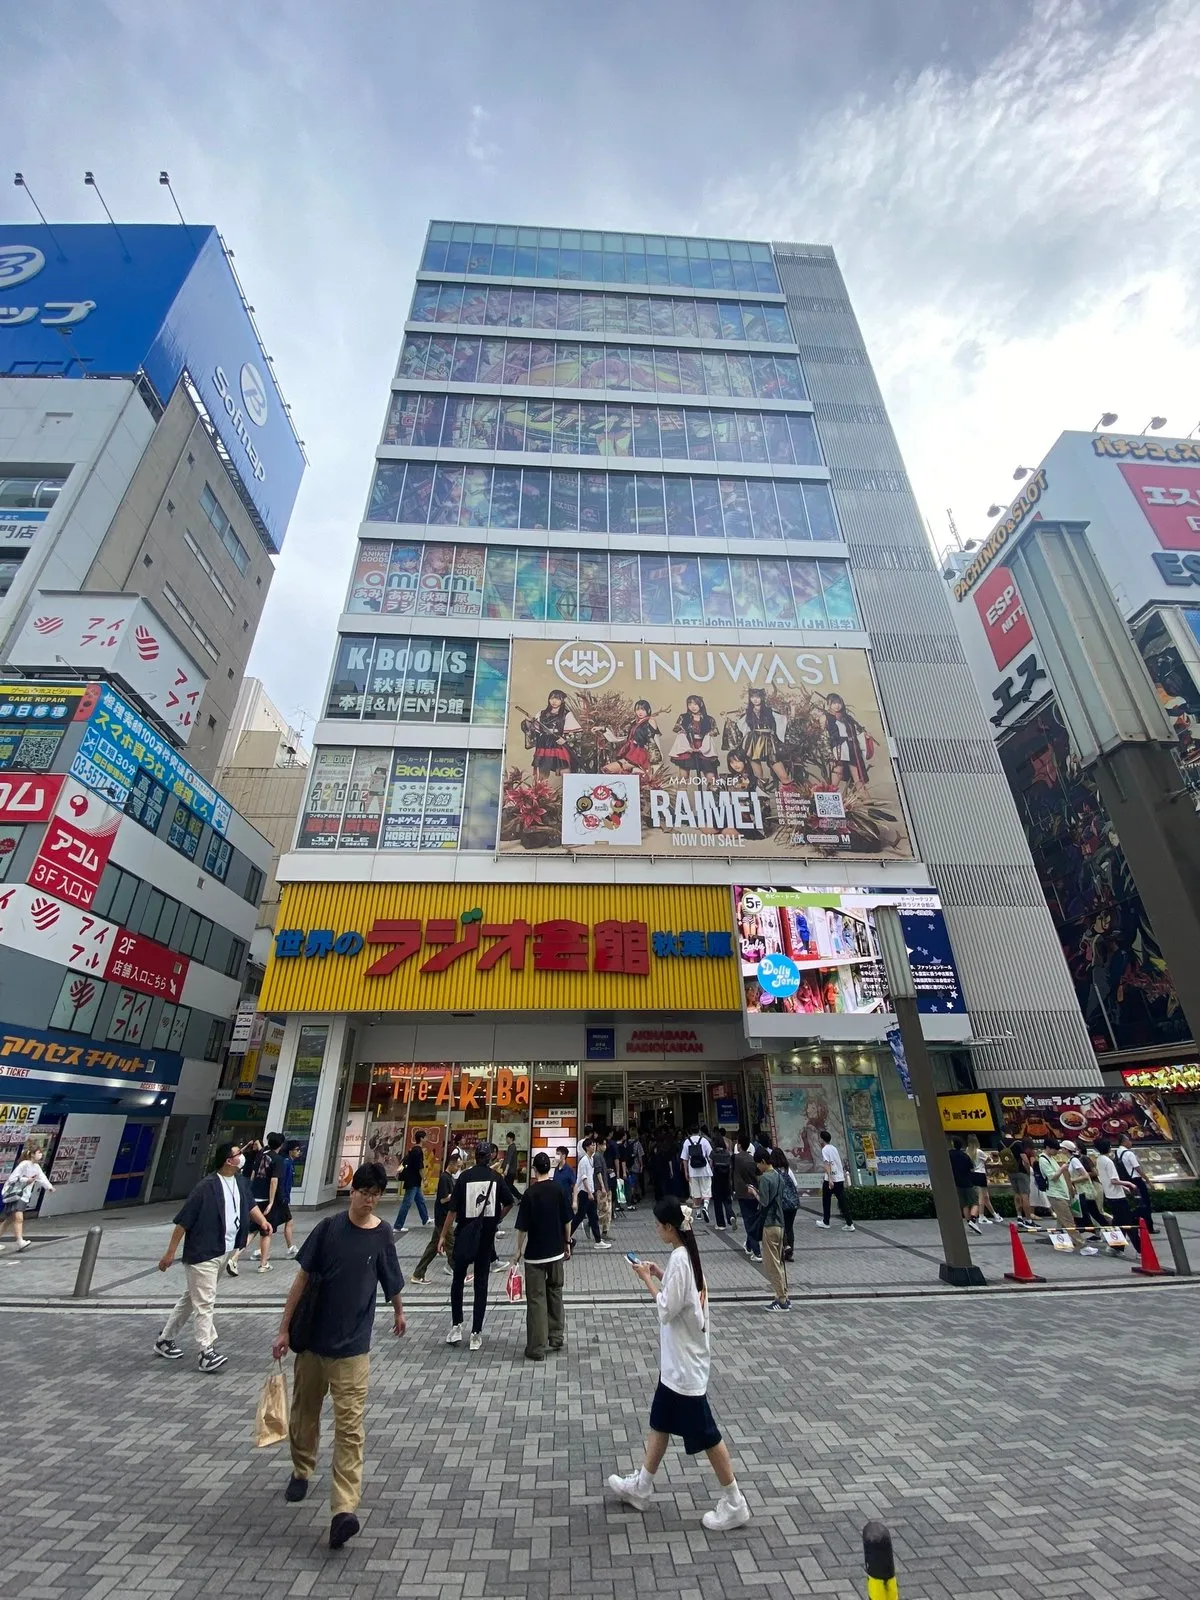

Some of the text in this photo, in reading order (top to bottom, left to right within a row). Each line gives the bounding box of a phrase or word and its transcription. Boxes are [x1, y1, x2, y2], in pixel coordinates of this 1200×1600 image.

[212, 365, 266, 482] Sofmap
[1092, 436, 1200, 462] パチンコ&ス
[88, 617, 125, 631] アイ
[705, 618, 731, 627] John
[79, 634, 118, 648] フル
[346, 647, 468, 674] K-BOOKS
[634, 649, 839, 686] INUWASI
[374, 677, 437, 695] 秋葉原
[395, 765, 464, 777] BIGMAGIC
[669, 776, 740, 786] MAJOR 1st EP
[650, 789, 764, 829] RAIMEI
[672, 833, 746, 848] NOW ON SALE
[50, 829, 100, 873] アコム
[745, 897, 761, 909] 5F
[79, 916, 110, 944] アイ
[118, 936, 137, 956] 2F
[274, 907, 735, 977] 世界の ラジオ会館 秋葉原
[69, 944, 99, 969] フル
[111, 960, 167, 990] 店舗入口こちら
[760, 959, 791, 977] Dolly
[631, 1030, 698, 1041] AKIHABARA
[626, 1042, 704, 1053] RADIOKAIKAN
[6, 1068, 31, 1078] TICKET
